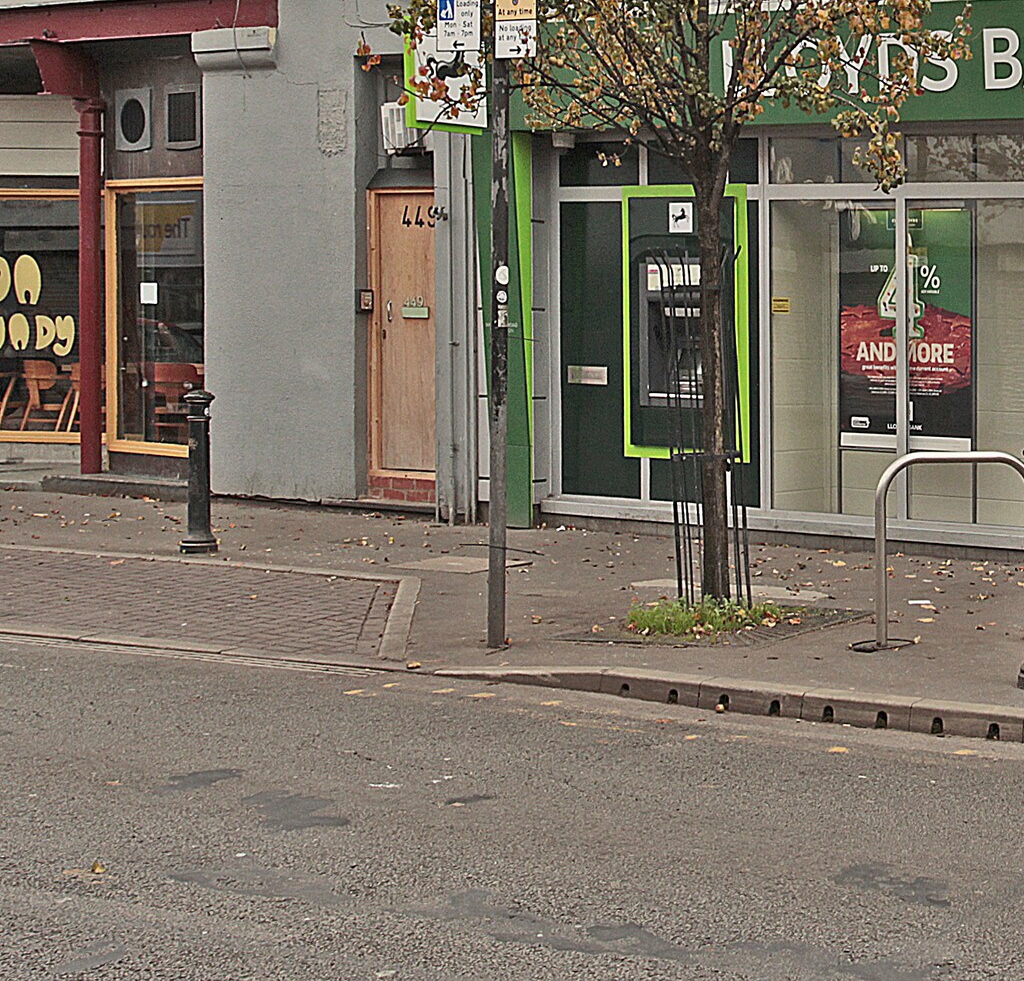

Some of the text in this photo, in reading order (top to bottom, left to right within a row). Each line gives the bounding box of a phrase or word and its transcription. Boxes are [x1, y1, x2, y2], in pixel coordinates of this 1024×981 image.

[456, 0, 479, 8] Loading
[509, 24, 532, 32] loading
[403, 295, 424, 307] 449
[856, 341, 897, 362] AND
